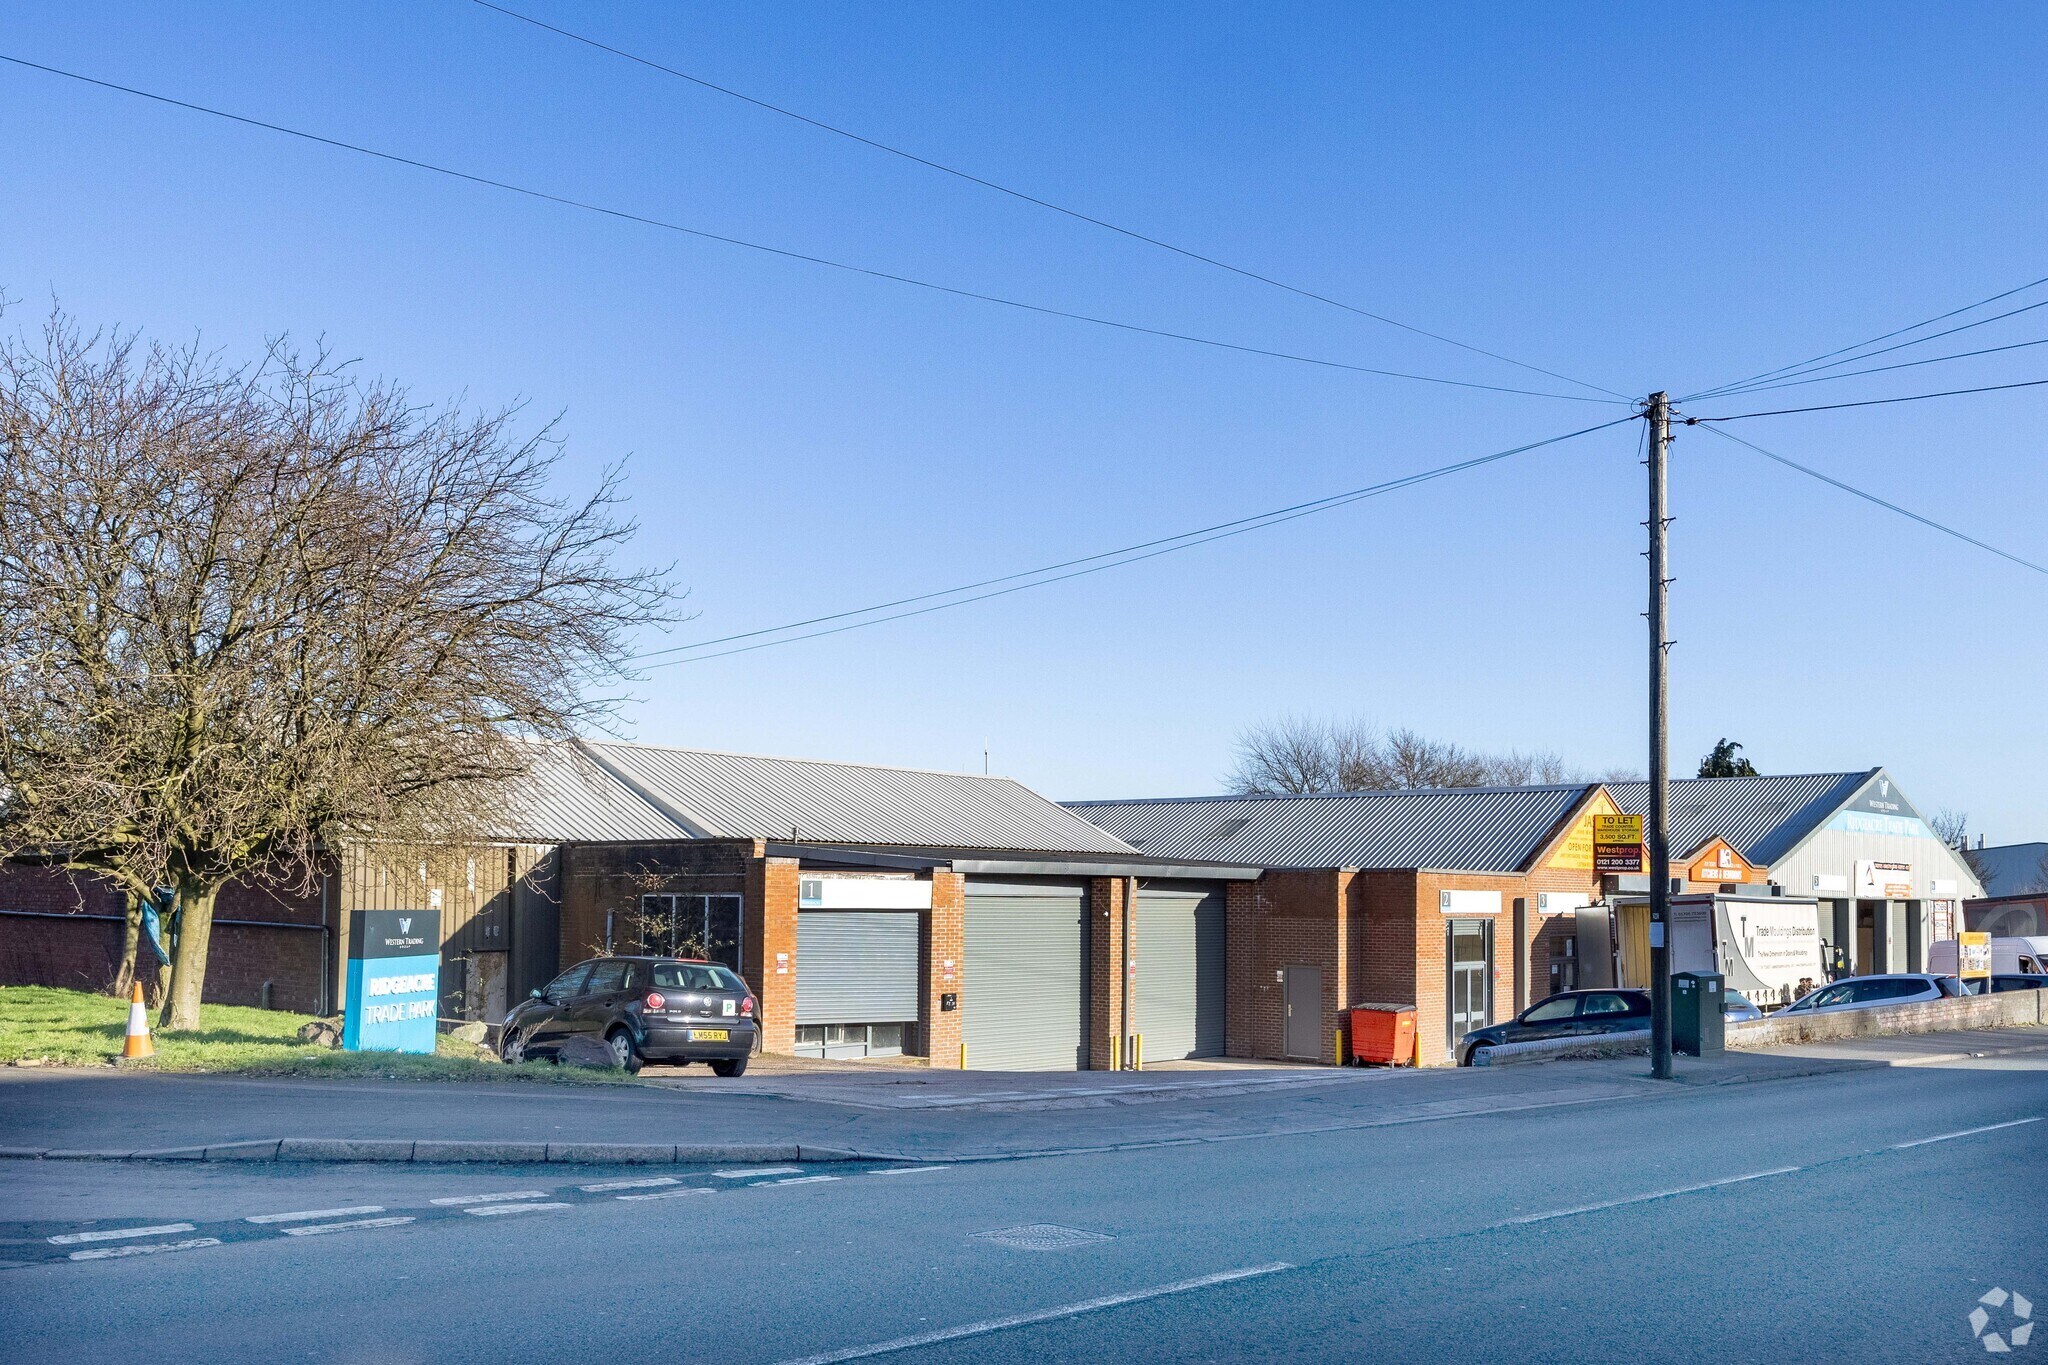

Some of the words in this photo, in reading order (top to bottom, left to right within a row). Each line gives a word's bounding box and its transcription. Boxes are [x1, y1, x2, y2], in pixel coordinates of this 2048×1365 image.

[1568, 842, 1581, 851] OPEN
[807, 882, 814, 899] 1
[1443, 892, 1449, 906] 2
[1540, 895, 1546, 907] 3
[1756, 926, 1769, 936] Trade
[1770, 925, 1791, 939] Mouldings
[1792, 925, 1815, 936] Distribution
[385, 938, 405, 946] WESTERN
[405, 937, 424, 945] TRADING
[369, 974, 435, 996] RIDGEACRE
[366, 1003, 406, 1025] TRADE
[408, 1001, 436, 1019] PARK
[726, 1004, 733, 1012] P
